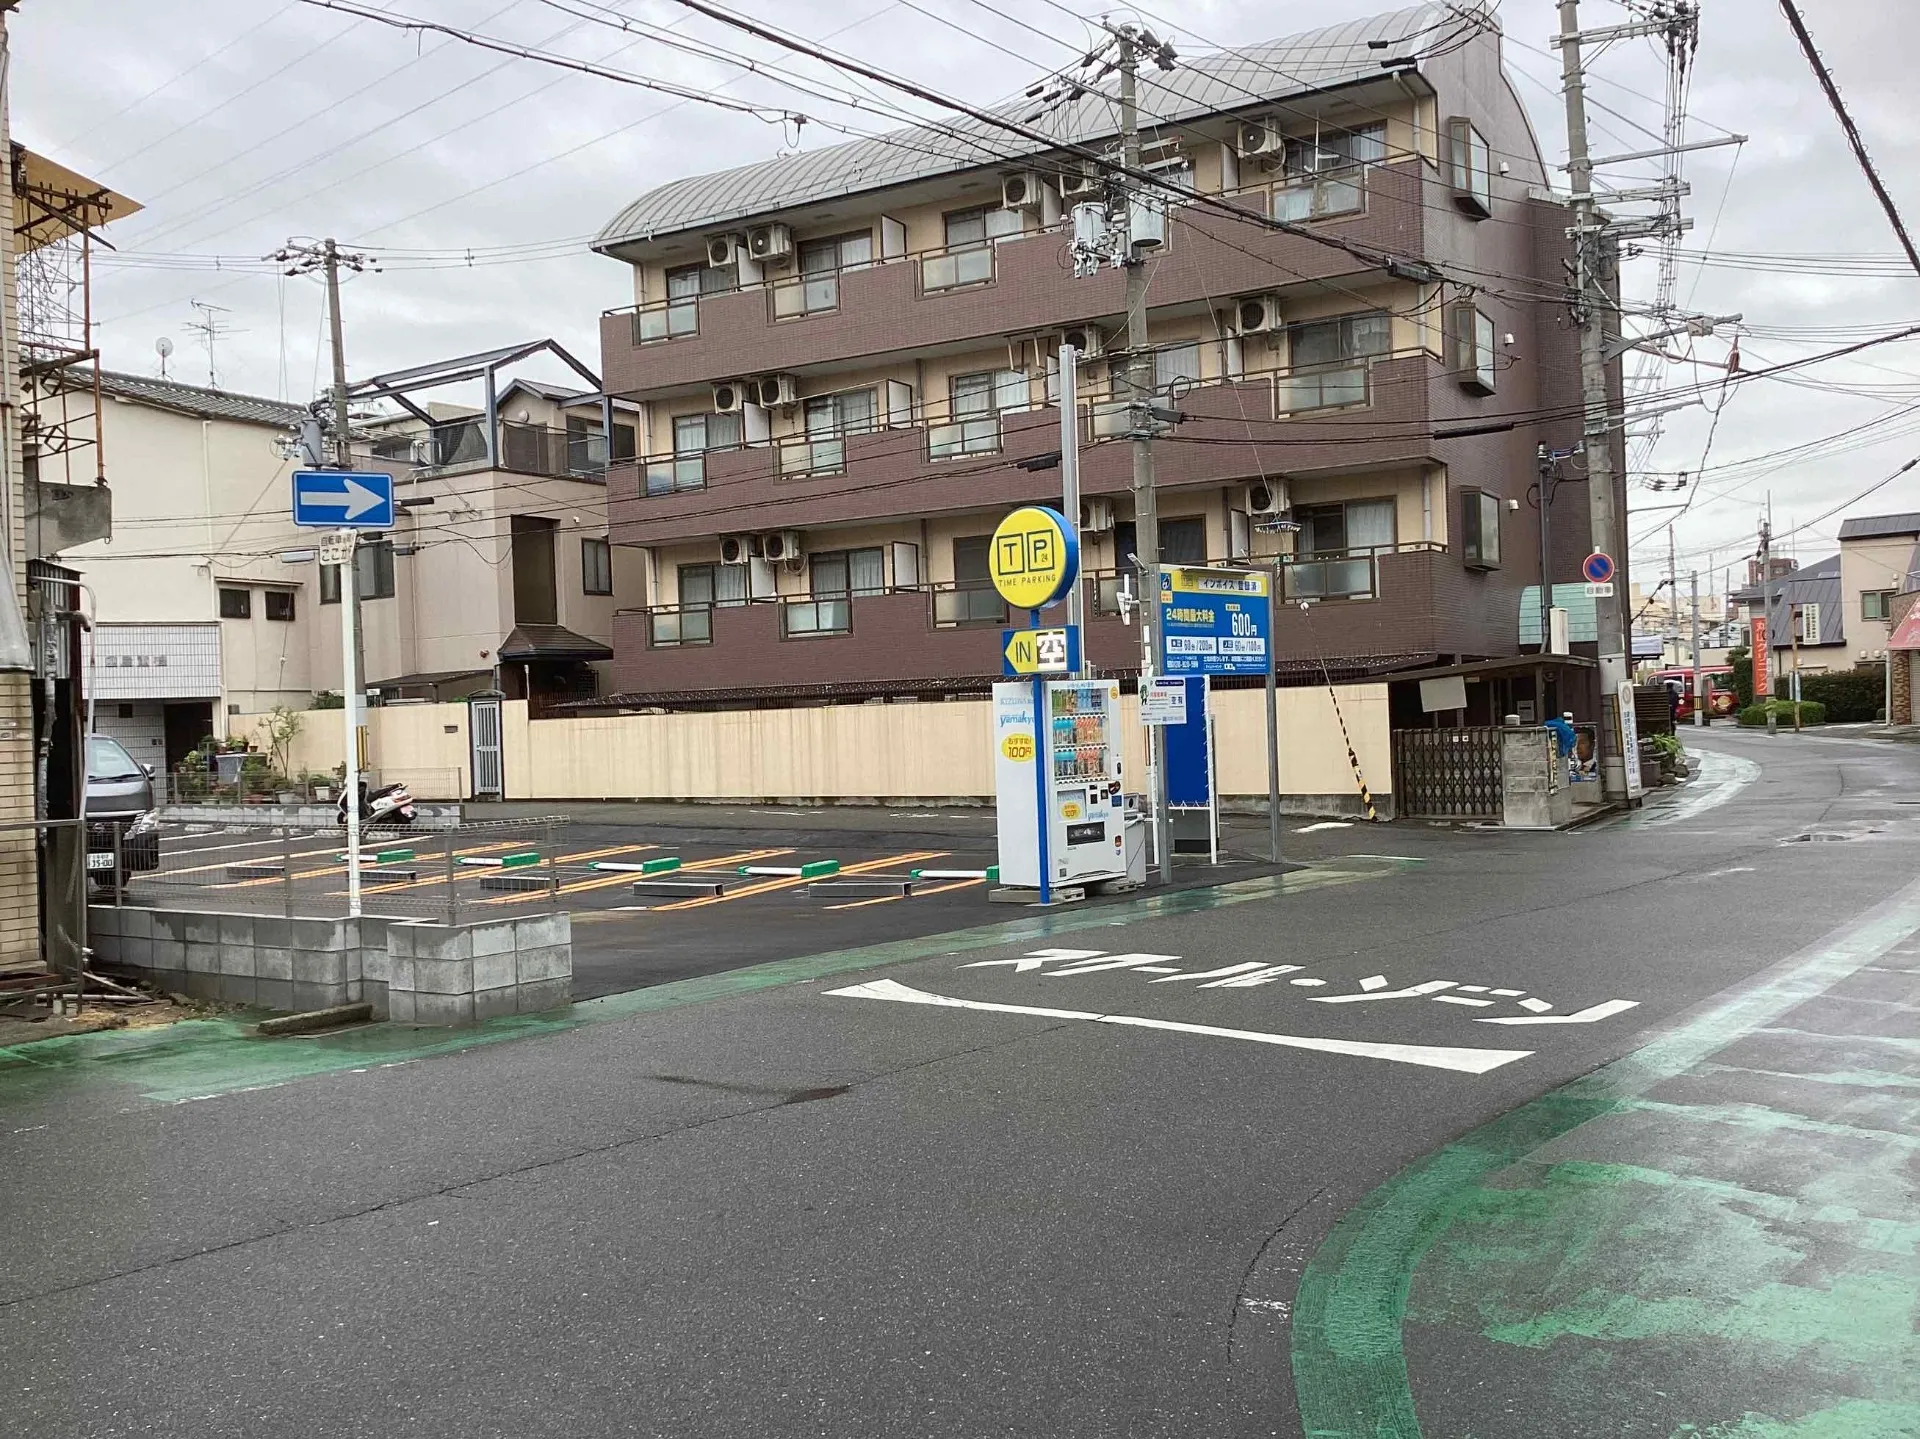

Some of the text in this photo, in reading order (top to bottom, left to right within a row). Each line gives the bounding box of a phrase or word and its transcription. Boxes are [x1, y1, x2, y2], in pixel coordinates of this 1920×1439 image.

[999, 574, 1056, 587] TIME PARKING
[1015, 641, 1031, 663] IN
[1000, 711, 1034, 727] yamaky
